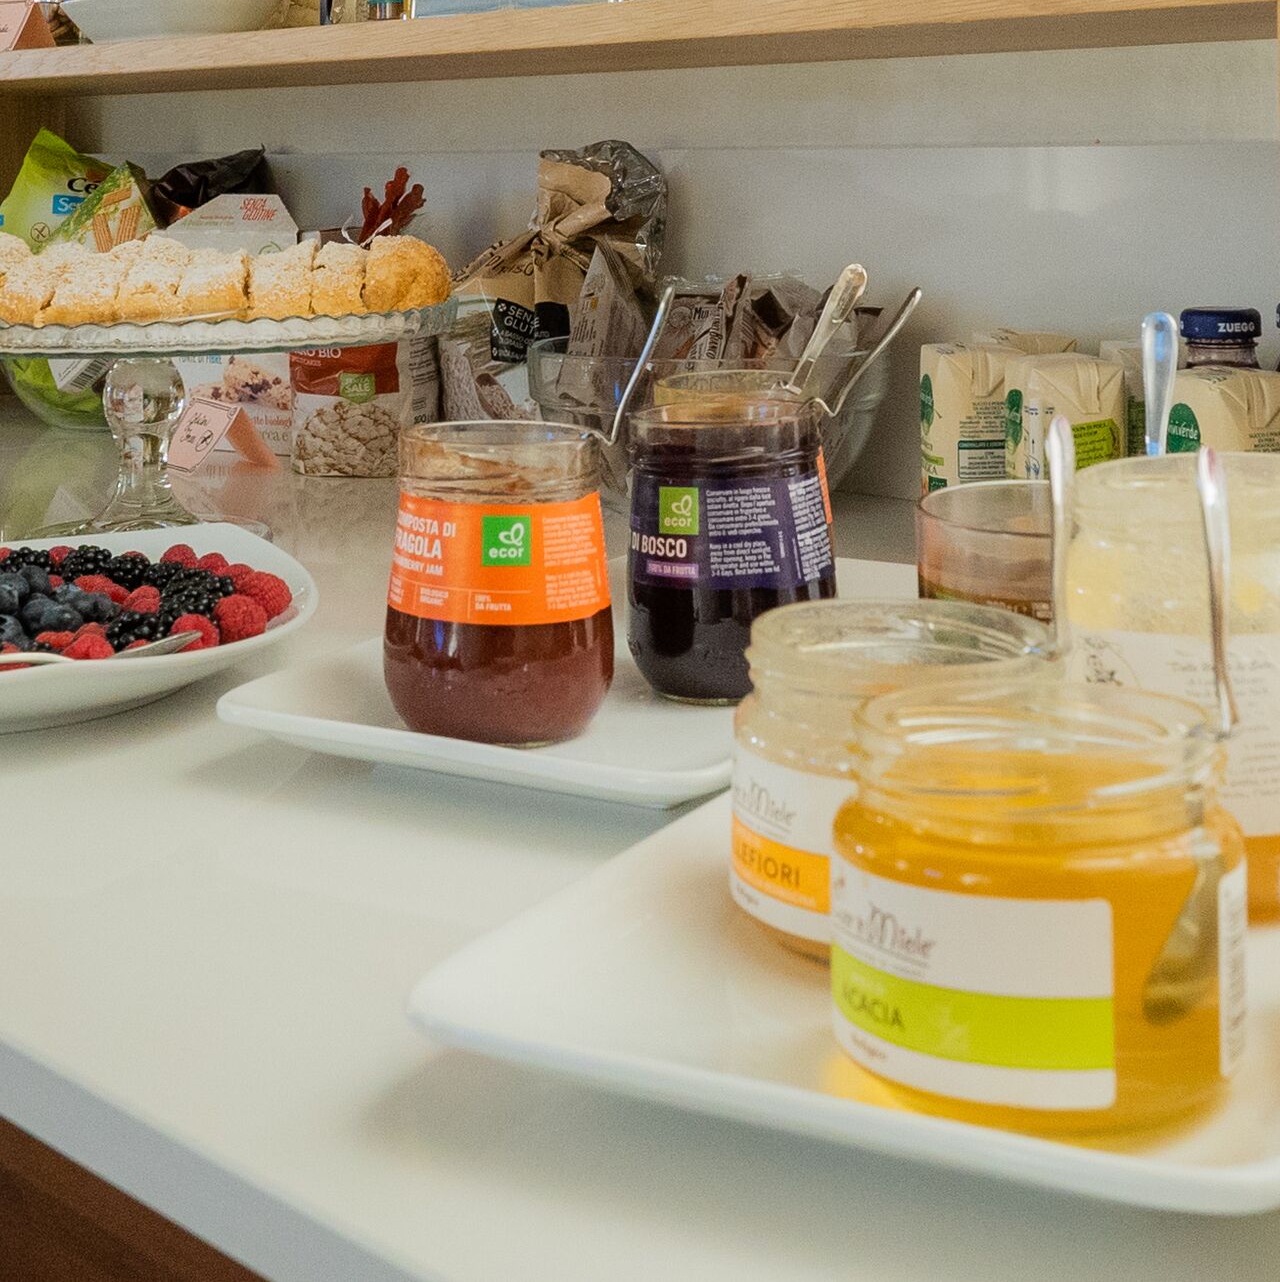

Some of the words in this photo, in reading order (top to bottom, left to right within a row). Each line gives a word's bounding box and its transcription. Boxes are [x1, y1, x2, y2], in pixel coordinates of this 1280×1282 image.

[1217, 321, 1255, 333] ZUEGG
[318, 347, 341, 359] BIO
[345, 383, 371, 393] SALE
[664, 517, 692, 527] ecor
[443, 522, 457, 538] DI
[396, 527, 443, 559] RAGOLA
[641, 534, 688, 558] BOSCO
[488, 547, 525, 559] ecor
